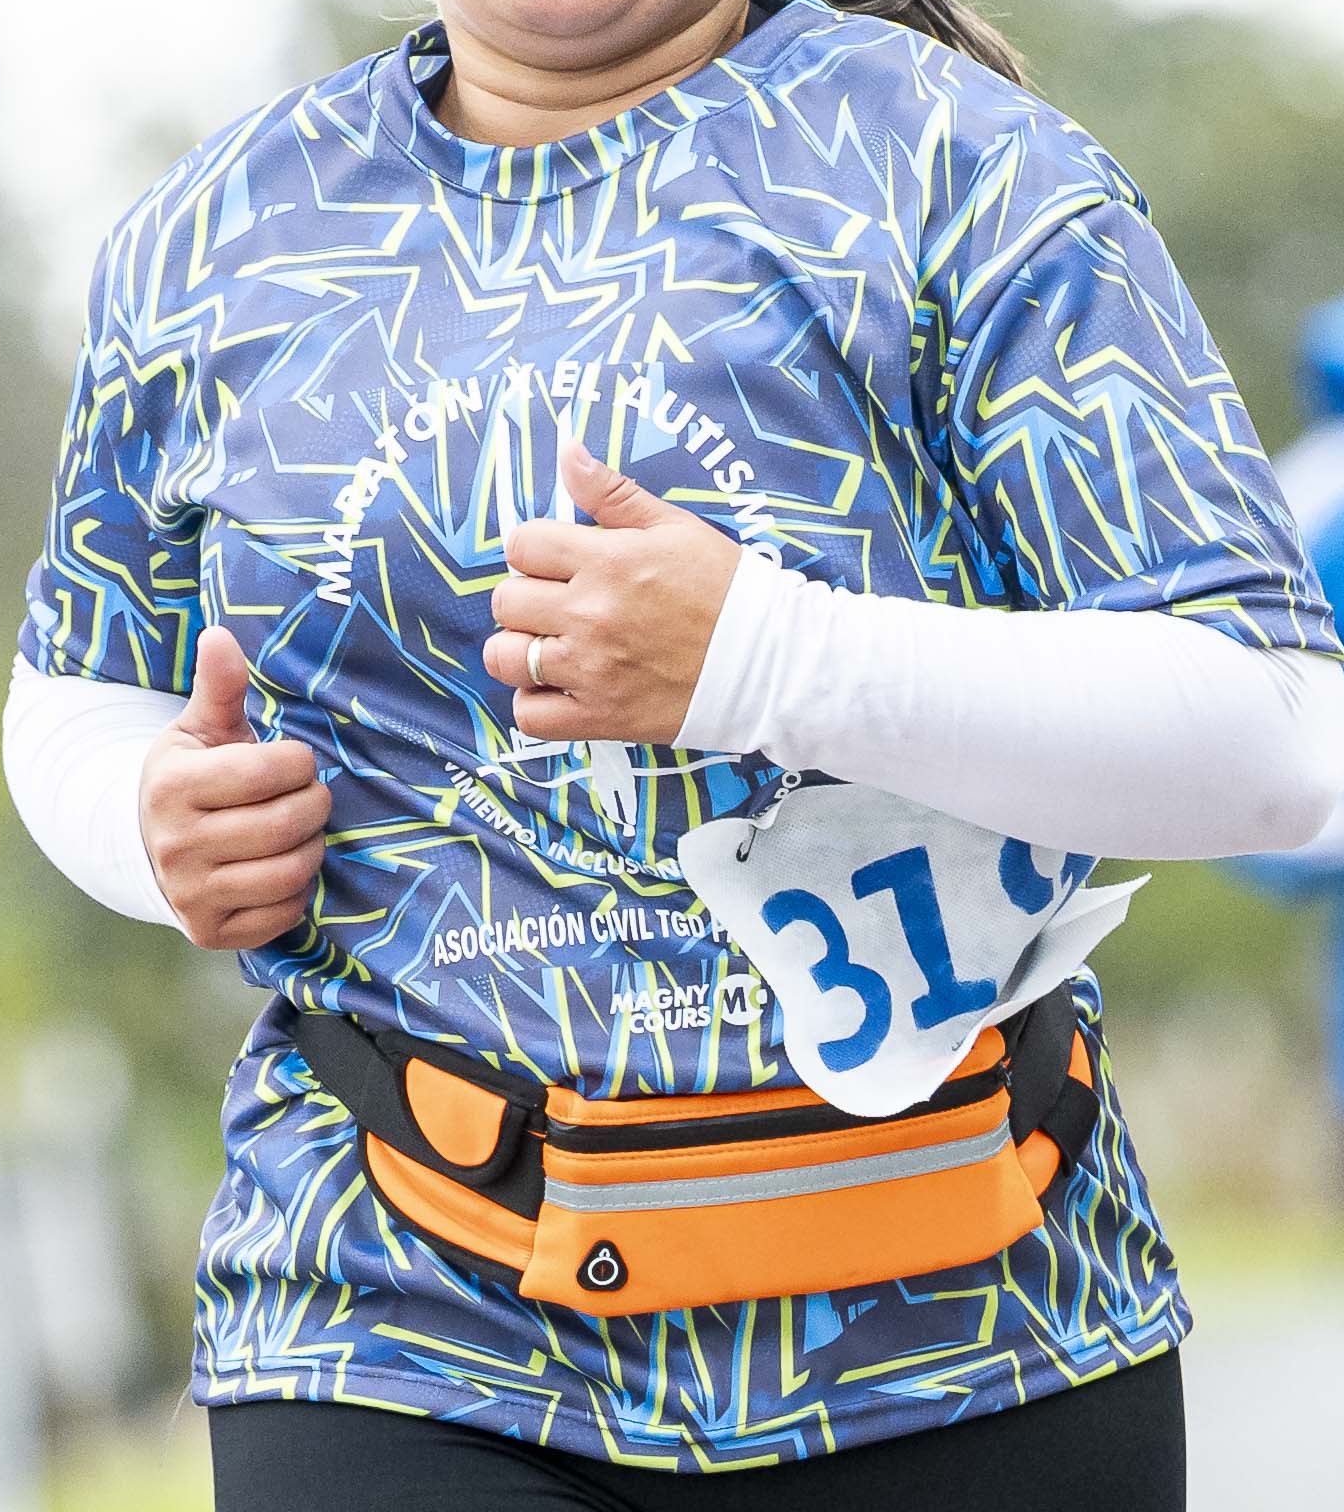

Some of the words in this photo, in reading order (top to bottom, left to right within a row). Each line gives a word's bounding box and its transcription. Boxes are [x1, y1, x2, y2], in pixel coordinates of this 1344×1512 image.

[316, 376, 484, 607] MARATÓN
[550, 360, 602, 402] EL
[433, 904, 585, 967] ASOCIACIÓN
[590, 908, 654, 943] CIVIL
[654, 908, 706, 939] TGD
[609, 983, 710, 1015] MAGNY
[629, 1005, 712, 1034] COURS
